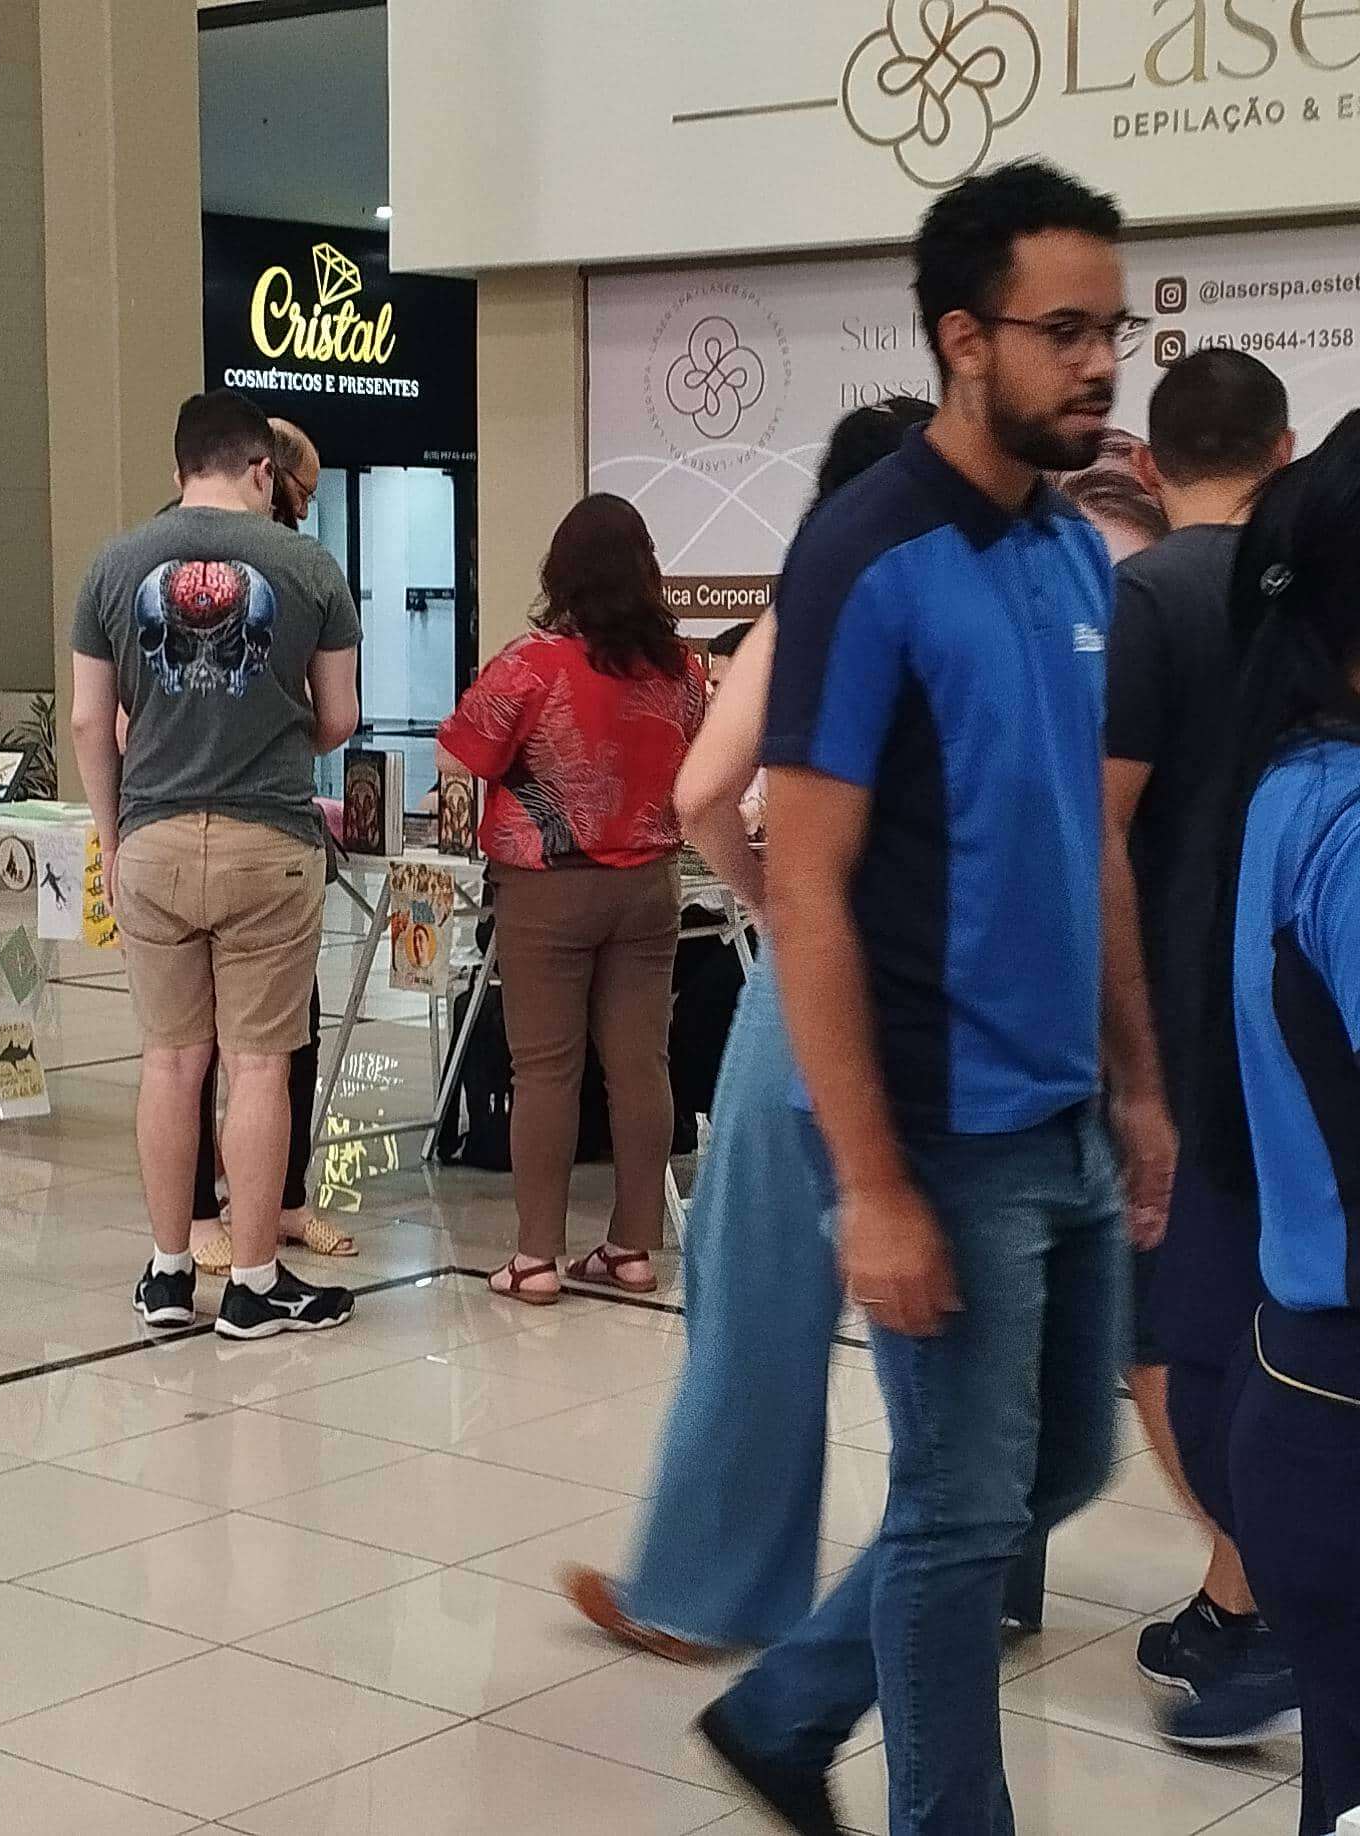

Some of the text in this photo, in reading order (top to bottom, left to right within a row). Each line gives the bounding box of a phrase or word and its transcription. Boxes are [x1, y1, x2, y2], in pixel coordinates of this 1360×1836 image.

[1112, 96, 1286, 139] DEPILAÇÃO
[1302, 97, 1320, 122] &
[251, 266, 396, 364] Cristal
[841, 318, 897, 351] Sua
[1240, 328, 1354, 351] 99644-1358
[224, 367, 420, 398] COSMÉTICOS E PRESENTES
[696, 583, 770, 610] Corporal
